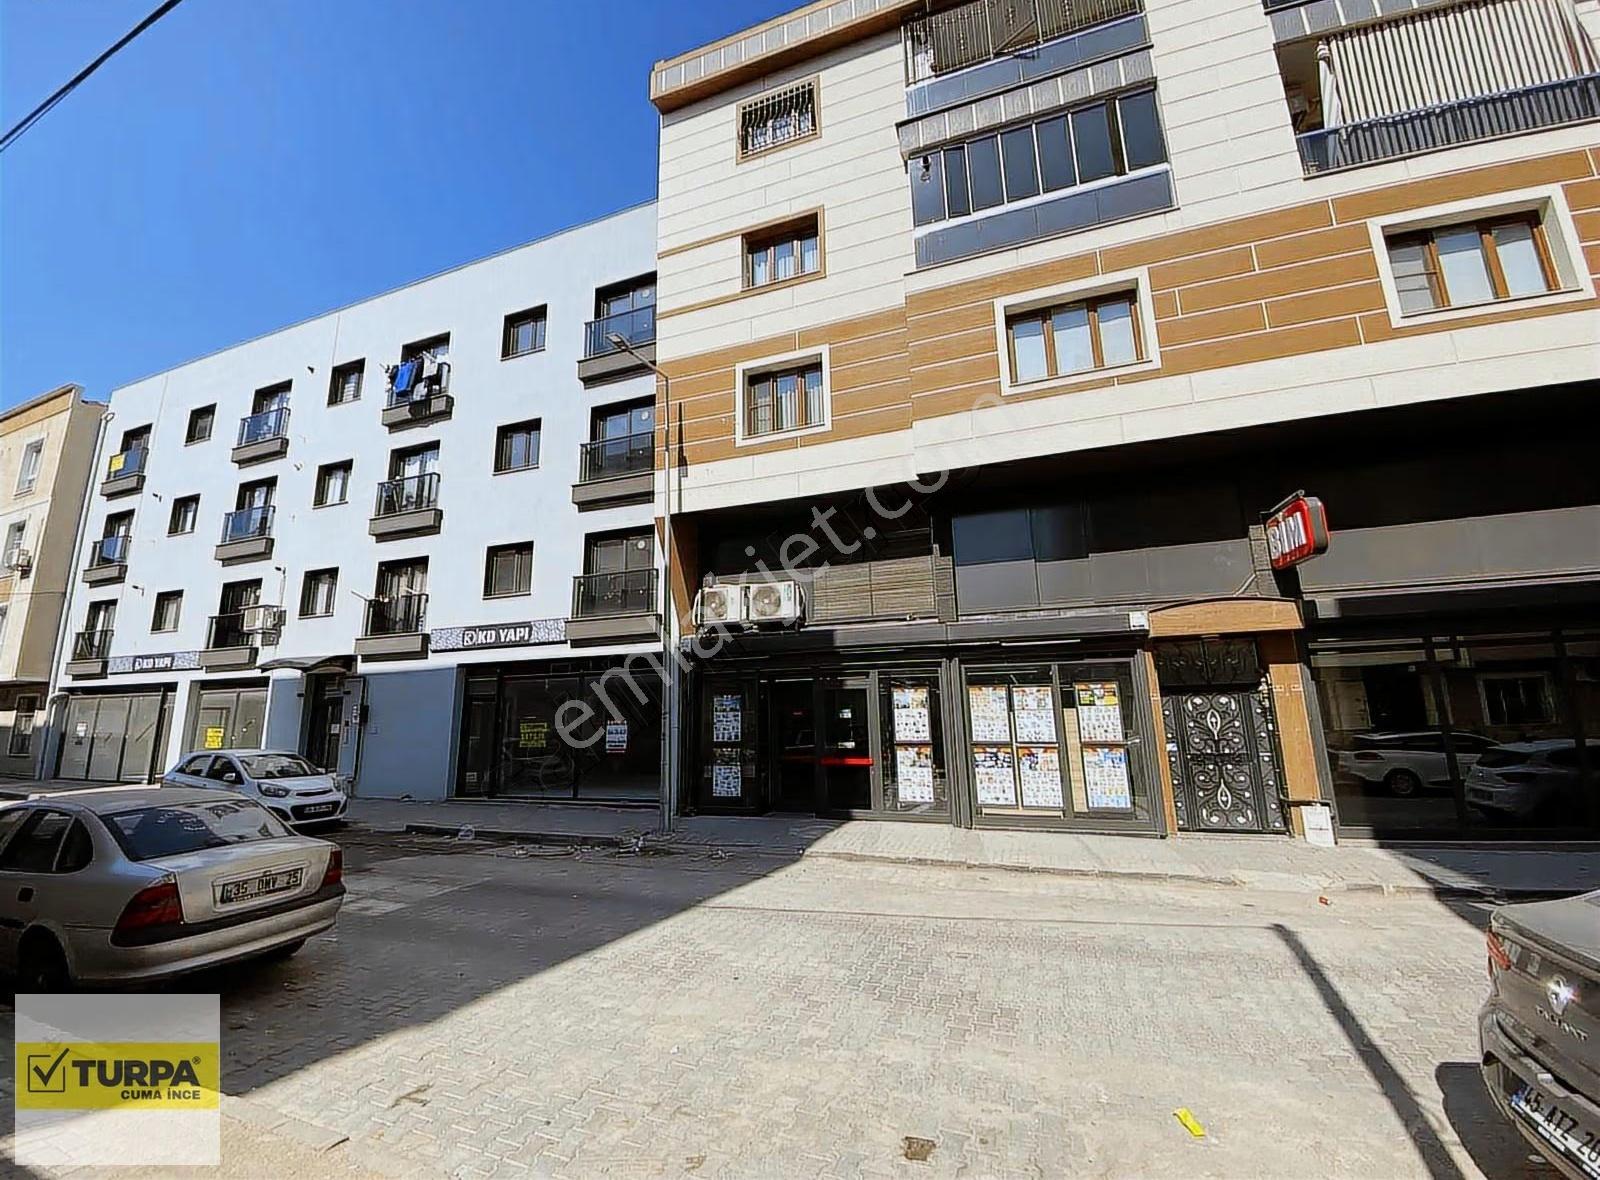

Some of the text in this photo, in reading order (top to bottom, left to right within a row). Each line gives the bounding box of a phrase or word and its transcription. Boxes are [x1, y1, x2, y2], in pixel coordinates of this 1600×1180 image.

[478, 627, 529, 644] KD YAPI
[1525, 1087, 1544, 1112] 45
[1545, 1105, 1579, 1141] ATZ
